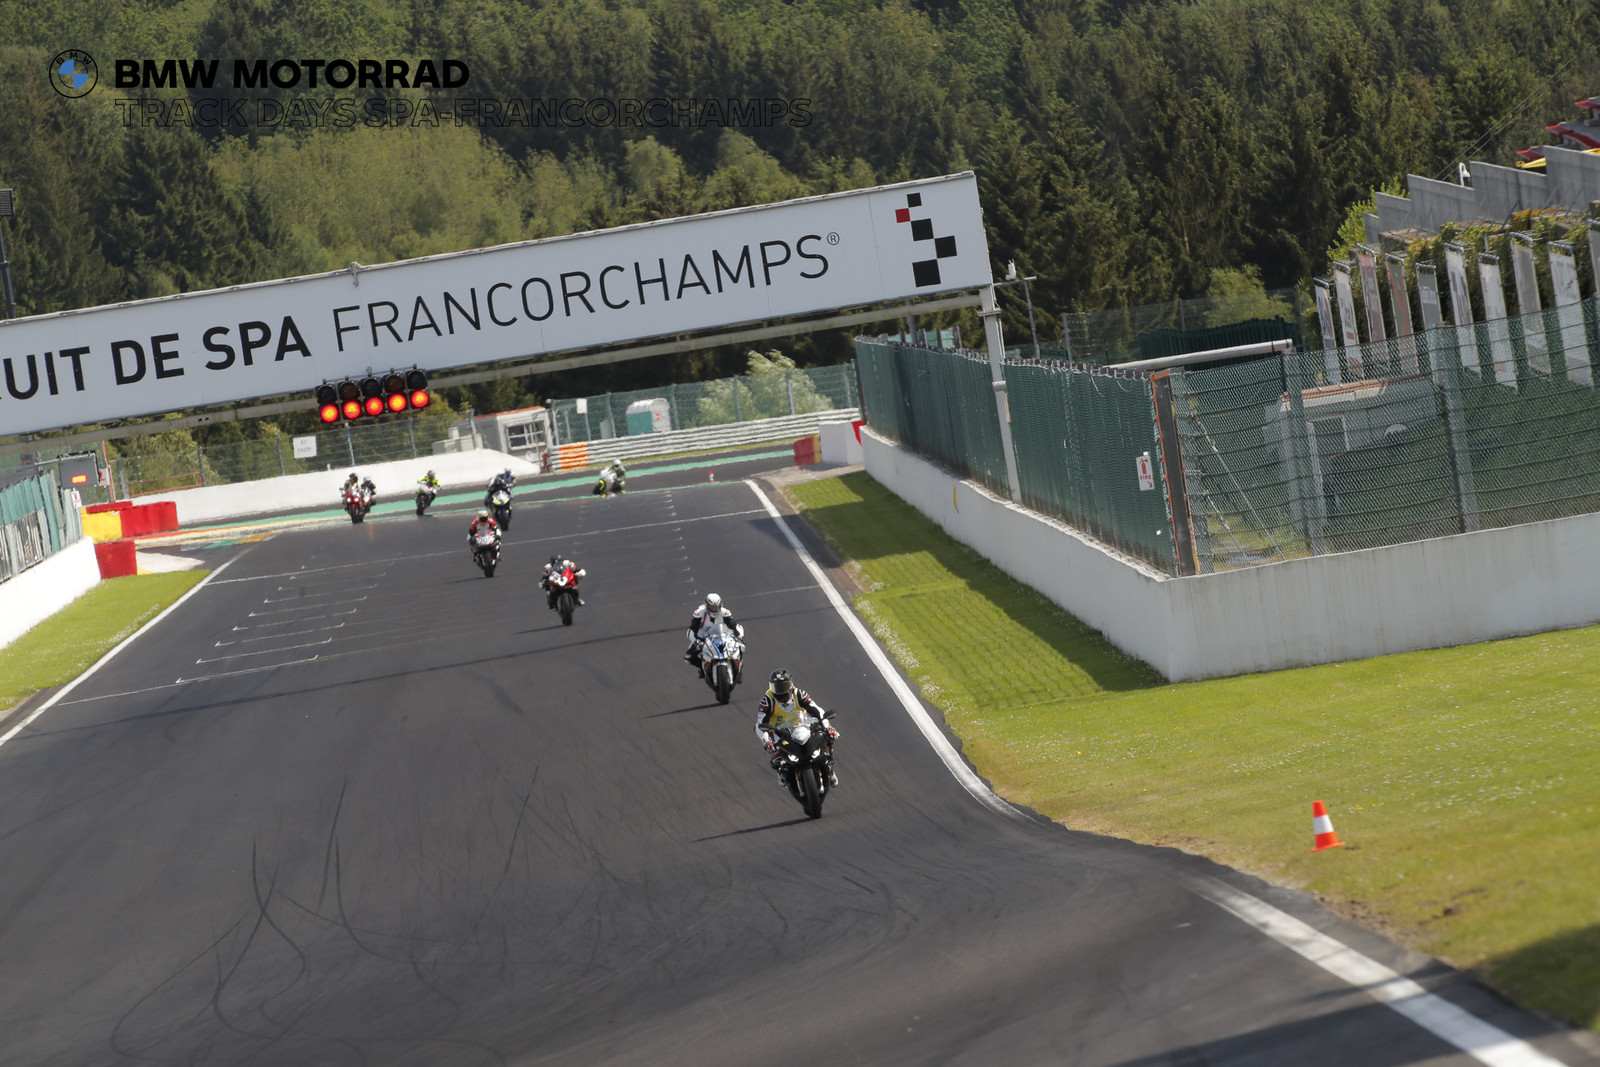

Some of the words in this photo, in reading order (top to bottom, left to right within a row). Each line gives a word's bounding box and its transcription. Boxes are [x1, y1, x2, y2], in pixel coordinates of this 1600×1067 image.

[0, 346, 91, 400] UIT
[110, 333, 185, 386] DE
[202, 316, 312, 371] SPA
